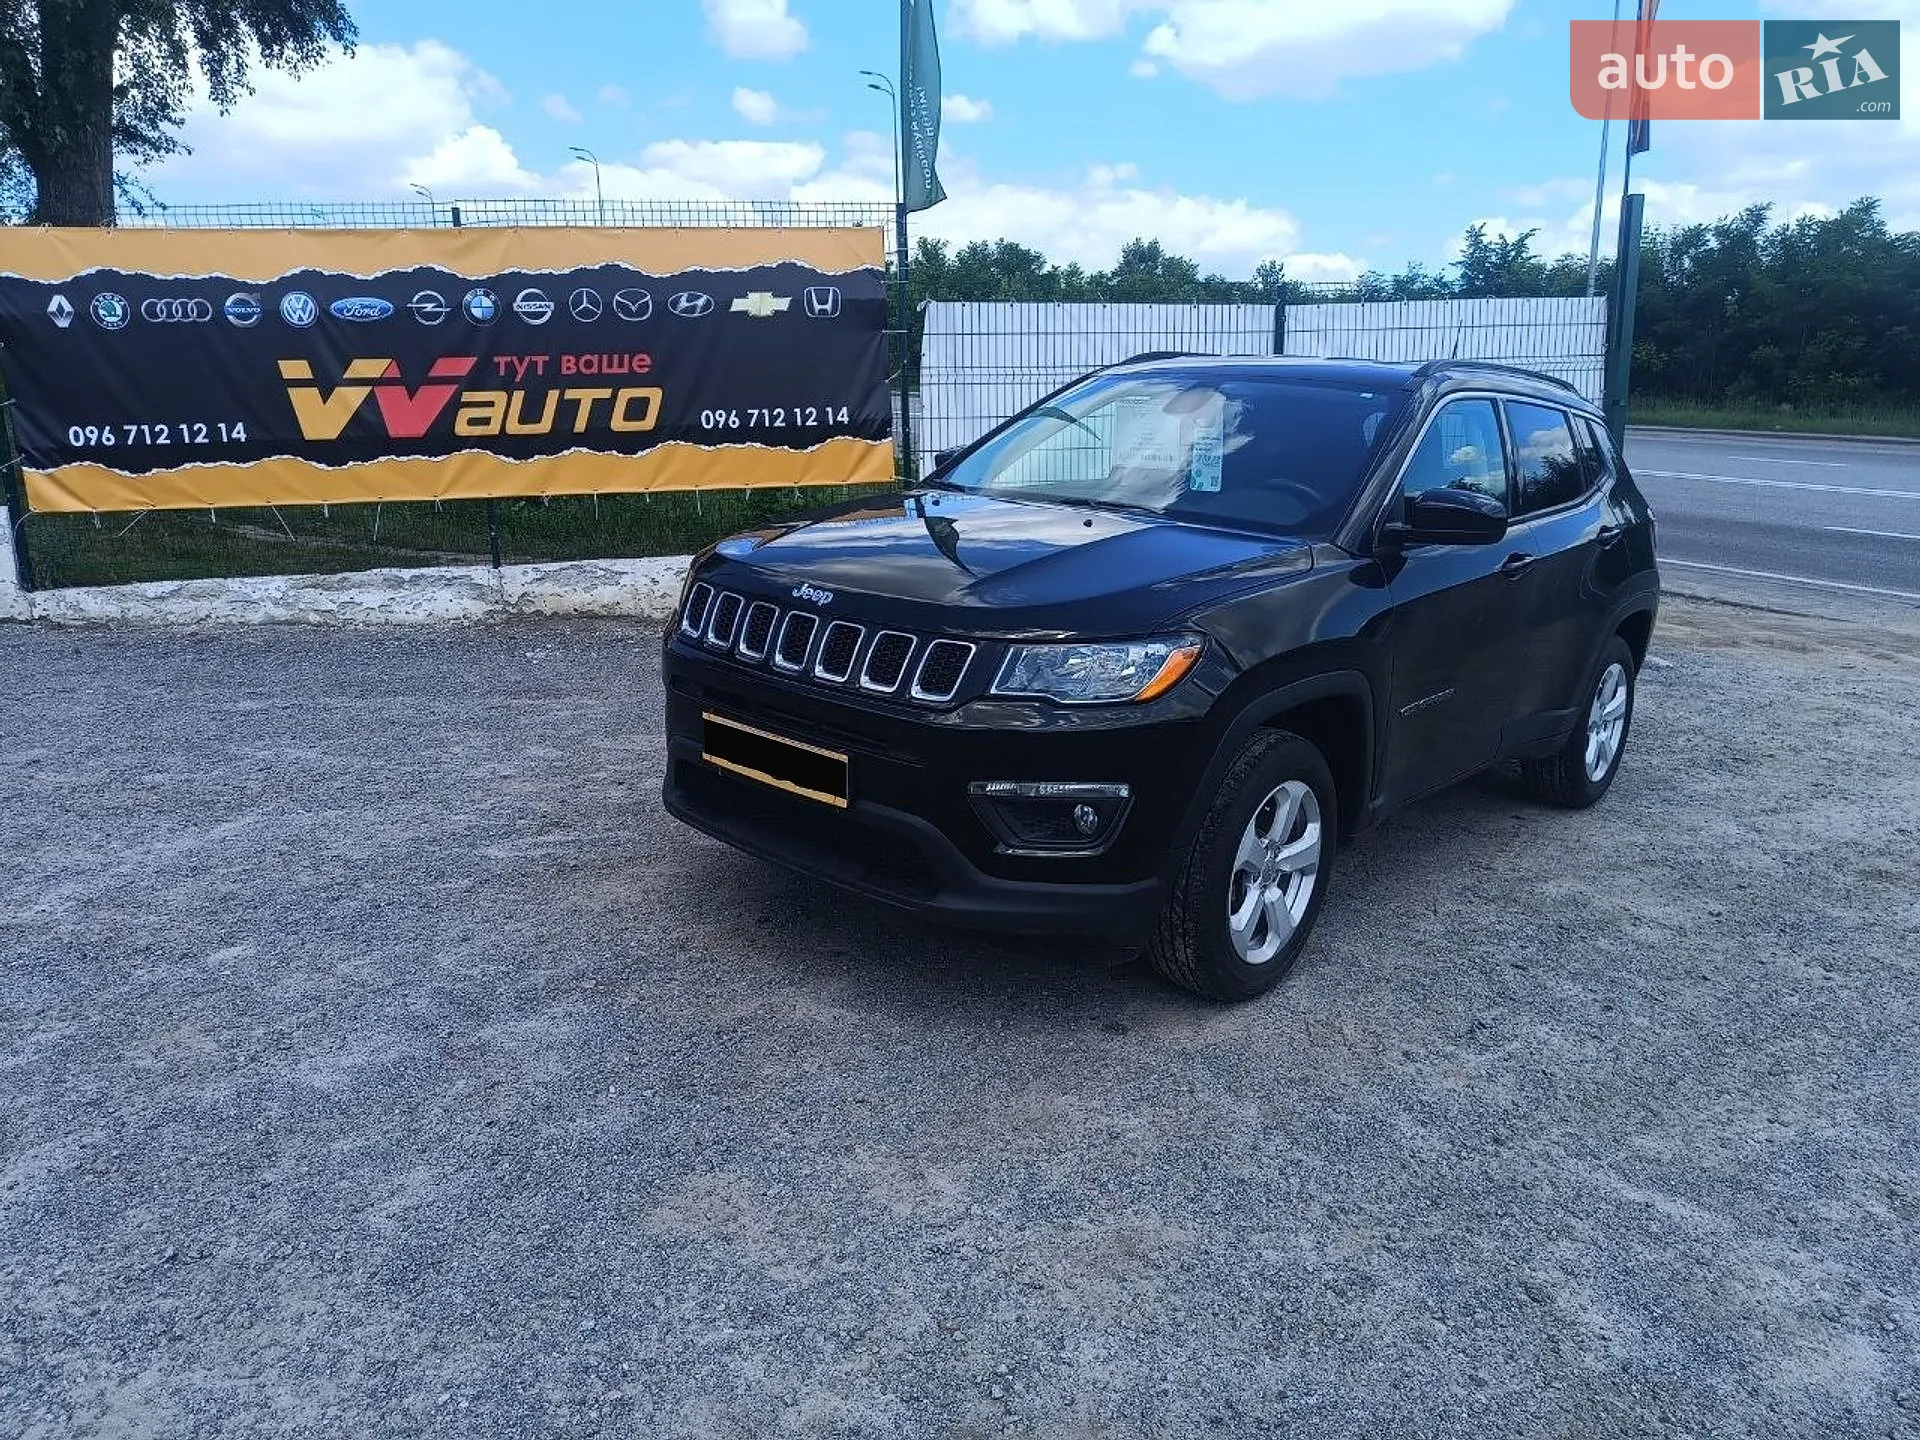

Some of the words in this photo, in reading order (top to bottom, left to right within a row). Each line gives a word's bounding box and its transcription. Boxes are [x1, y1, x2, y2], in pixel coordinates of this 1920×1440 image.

[343, 303, 381, 318] Ford
[515, 302, 551, 311] NISSAN
[493, 354, 549, 382] тут
[560, 351, 652, 376] ваше
[700, 409, 740, 429] 096
[747, 407, 786, 427] 712
[793, 407, 818, 426] 12
[825, 406, 849, 425] 14
[68, 425, 116, 447] 096
[123, 424, 171, 445] 712
[178, 423, 210, 444] 12
[217, 422, 247, 443] 14
[791, 583, 834, 607] Jeep
